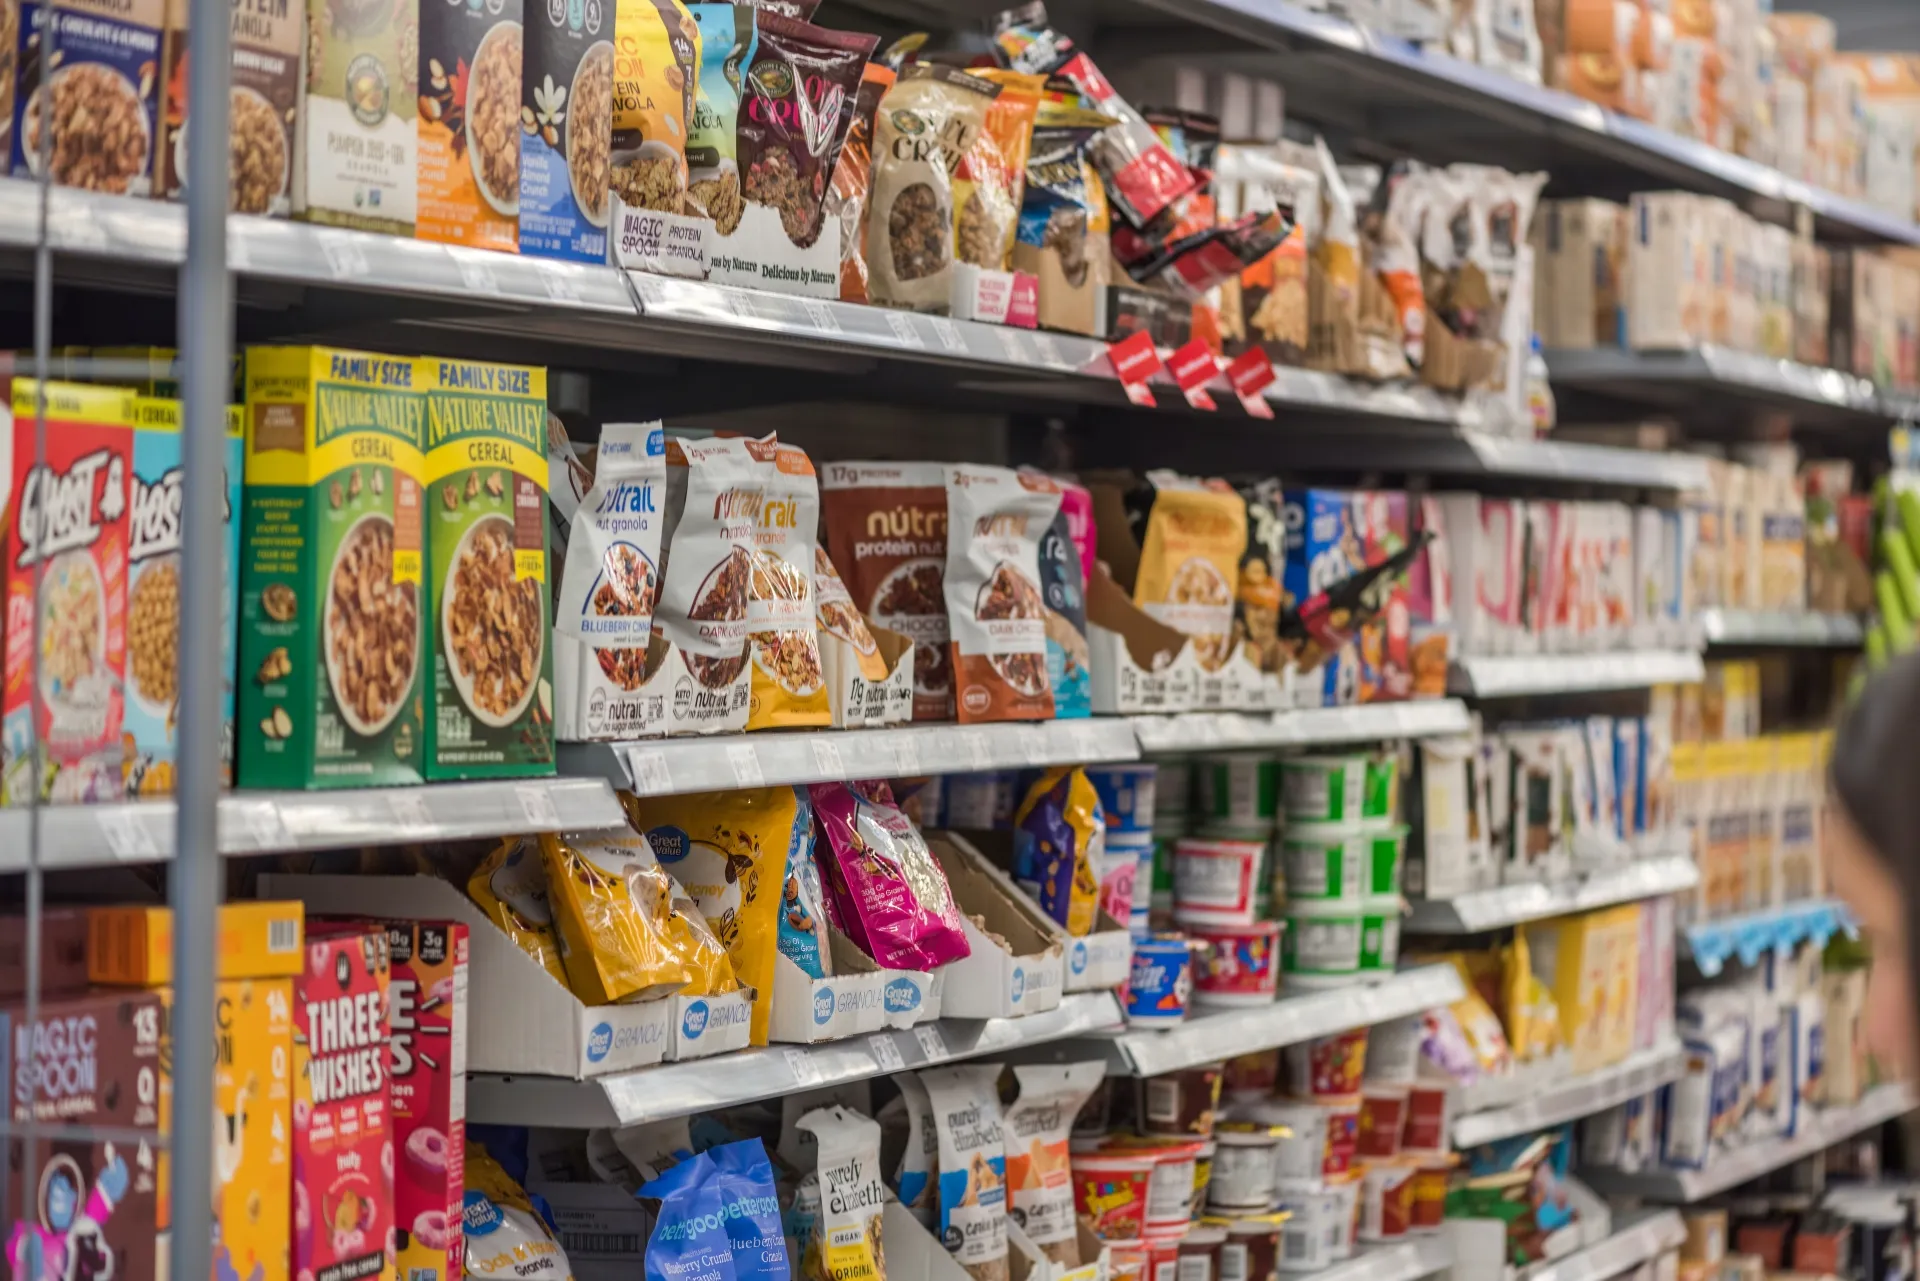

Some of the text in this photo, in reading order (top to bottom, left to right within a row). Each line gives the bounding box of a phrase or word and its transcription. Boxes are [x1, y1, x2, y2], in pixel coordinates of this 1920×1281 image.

[522, 154, 548, 169] Vanilla
[521, 171, 550, 184] Almond
[521, 184, 548, 197] Crunch
[624, 214, 663, 238] MAGIC
[669, 225, 702, 242] PROTEIN
[621, 235, 660, 258] SPOON
[667, 244, 704, 263] GRANOLA
[722, 257, 732, 273] by
[732, 256, 758, 273] Nature
[762, 263, 836, 286] Delicious by Nature
[331, 353, 412, 387] FAMILY SIZE
[439, 366, 530, 394] FAMILY SIZE
[318, 388, 425, 448] NATURE VALLEY
[428, 395, 543, 453] NATURE VALLEY
[351, 438, 394, 462] CEREAL
[468, 442, 514, 465] CEREAL
[831, 466, 858, 483] 17g
[953, 471, 970, 488] 2g
[611, 515, 648, 535] granola
[855, 539, 943, 561] protein nut
[581, 619, 632, 633] BLUEBERRY
[699, 624, 727, 638] DARK
[889, 617, 945, 632] CHOCO
[675, 690, 691, 700] KETO
[850, 677, 865, 704] 17g
[603, 719, 647, 734] no sugar added
[650, 834, 681, 850] Great
[656, 845, 682, 857] Value
[390, 930, 443, 947] 8g 3g
[837, 987, 883, 1013] GRANOLA
[885, 985, 914, 1001] Great
[814, 995, 832, 1011] Great
[306, 991, 382, 1056] THREE
[685, 1009, 706, 1023] Great
[15, 1015, 97, 1064] MAGIC
[589, 1031, 609, 1046] Great
[15, 1055, 97, 1103] SPOON
[307, 1047, 382, 1105] WISHES
[336, 1151, 362, 1172] fruity
[826, 1157, 862, 1194] purely
[830, 1180, 883, 1215] elizabeth
[467, 1210, 497, 1229] Value
[358, 1257, 381, 1275] cereal
[664, 1258, 700, 1276] Blueberry
[835, 1264, 873, 1281] ORIGINAL
